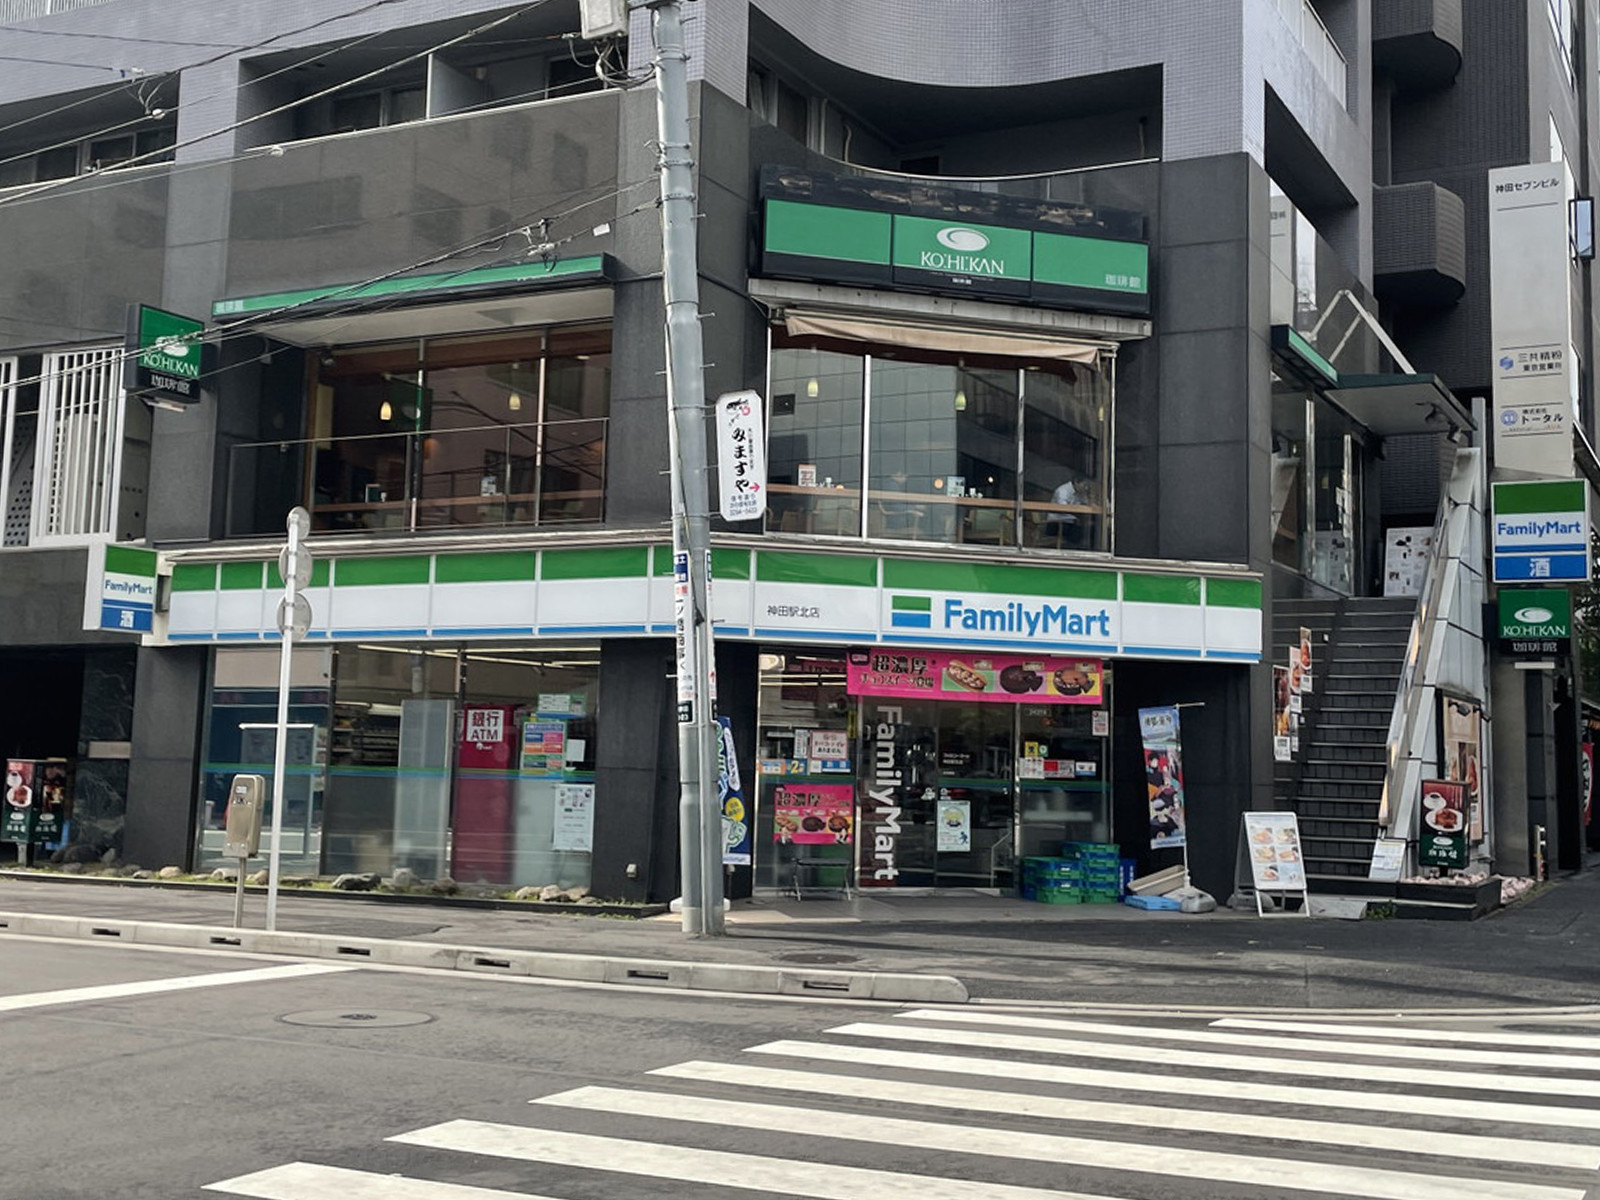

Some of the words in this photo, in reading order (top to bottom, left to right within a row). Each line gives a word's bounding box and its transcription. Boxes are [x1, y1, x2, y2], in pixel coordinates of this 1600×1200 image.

[1495, 178, 1560, 193] 神田セブンビル
[731, 427, 750, 493] みますや
[1497, 521, 1582, 538] FamilyMart
[1529, 557, 1551, 577] 酒
[104, 580, 153, 595] FamilyMart
[767, 604, 821, 618] 神田駅北店
[944, 598, 1111, 637] FamilyMart
[871, 654, 929, 675] 超濃厚
[472, 711, 500, 728] 銀行
[470, 729, 499, 741] ATM
[868, 705, 903, 881] FamilyMart
